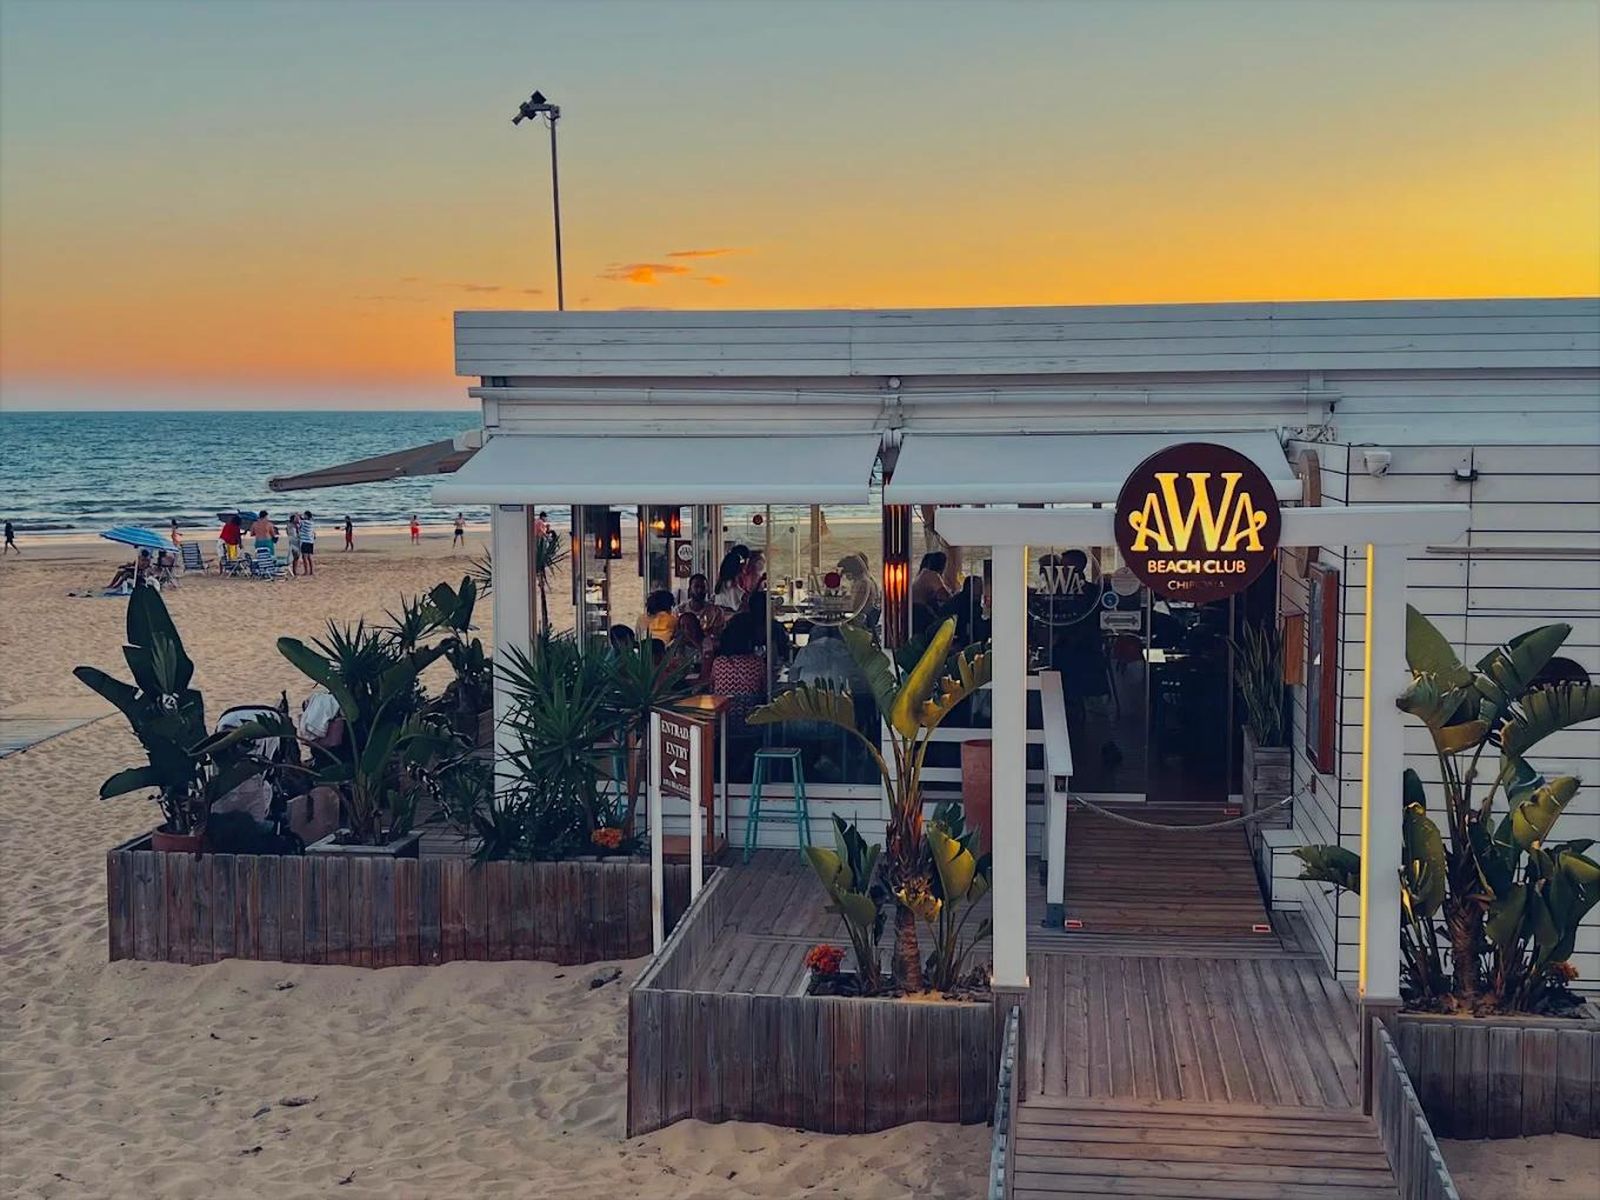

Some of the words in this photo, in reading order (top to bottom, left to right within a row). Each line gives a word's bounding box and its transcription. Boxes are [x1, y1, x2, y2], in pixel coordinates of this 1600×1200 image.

[1128, 472, 1268, 552] AWA
[1147, 559, 1201, 574] BEACH
[1203, 559, 1247, 574] CLUB
[1035, 565, 1086, 595] AWA
[661, 720, 690, 740] ENTRAD
[665, 741, 689, 760] ENTRY
